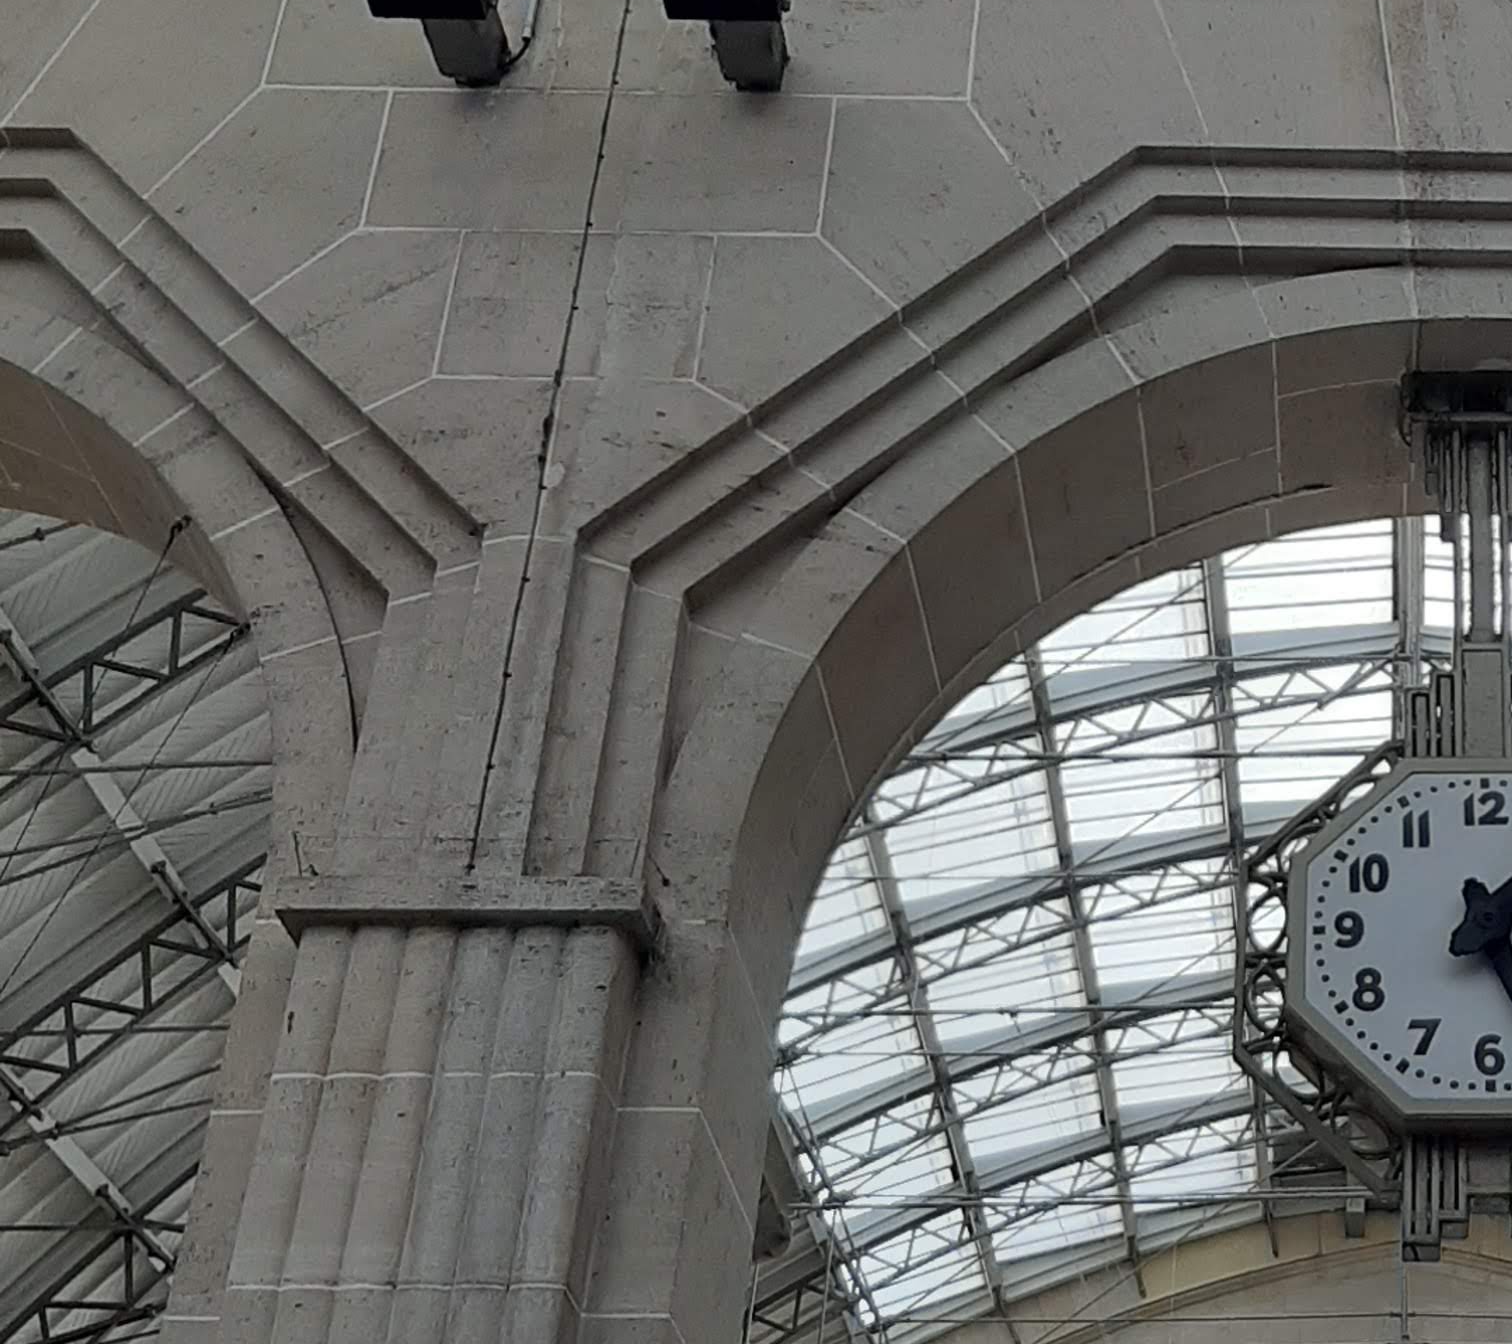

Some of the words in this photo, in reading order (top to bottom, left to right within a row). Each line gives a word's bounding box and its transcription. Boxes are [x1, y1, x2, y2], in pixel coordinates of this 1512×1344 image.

[1463, 790, 1510, 827] 12
[1402, 810, 1431, 849] 11
[1348, 853, 1390, 894] 10
[1333, 910, 1365, 949] 9
[1351, 967, 1386, 1013] 8
[1407, 1018, 1442, 1056] 7
[1473, 1034, 1506, 1077] 6
